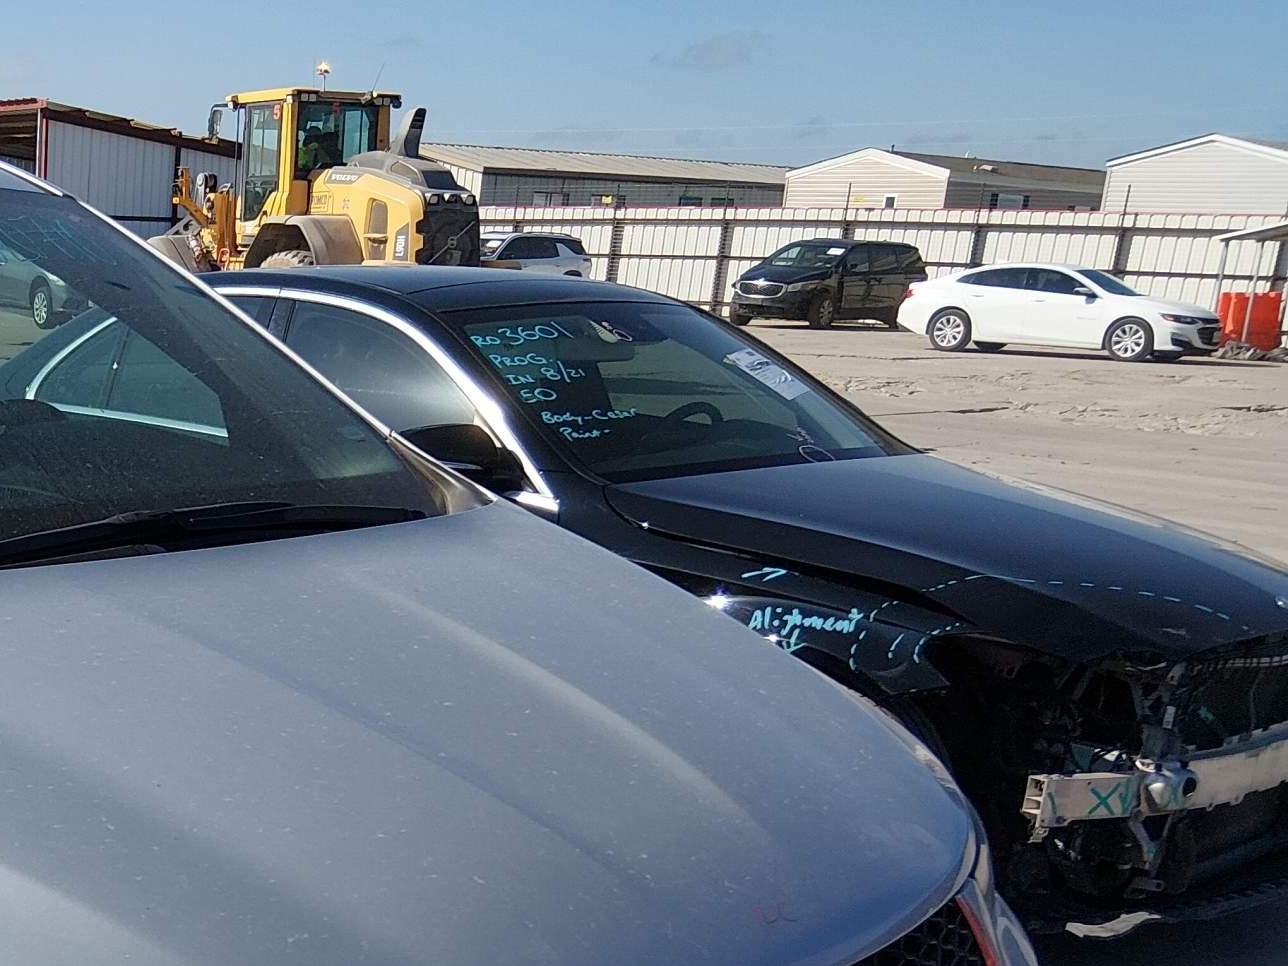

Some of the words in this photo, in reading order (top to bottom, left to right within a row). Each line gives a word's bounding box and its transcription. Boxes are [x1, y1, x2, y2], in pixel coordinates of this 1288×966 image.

[273, 104, 281, 120] 5
[331, 174, 358, 182] VOLVO
[505, 374, 536, 385] IN
